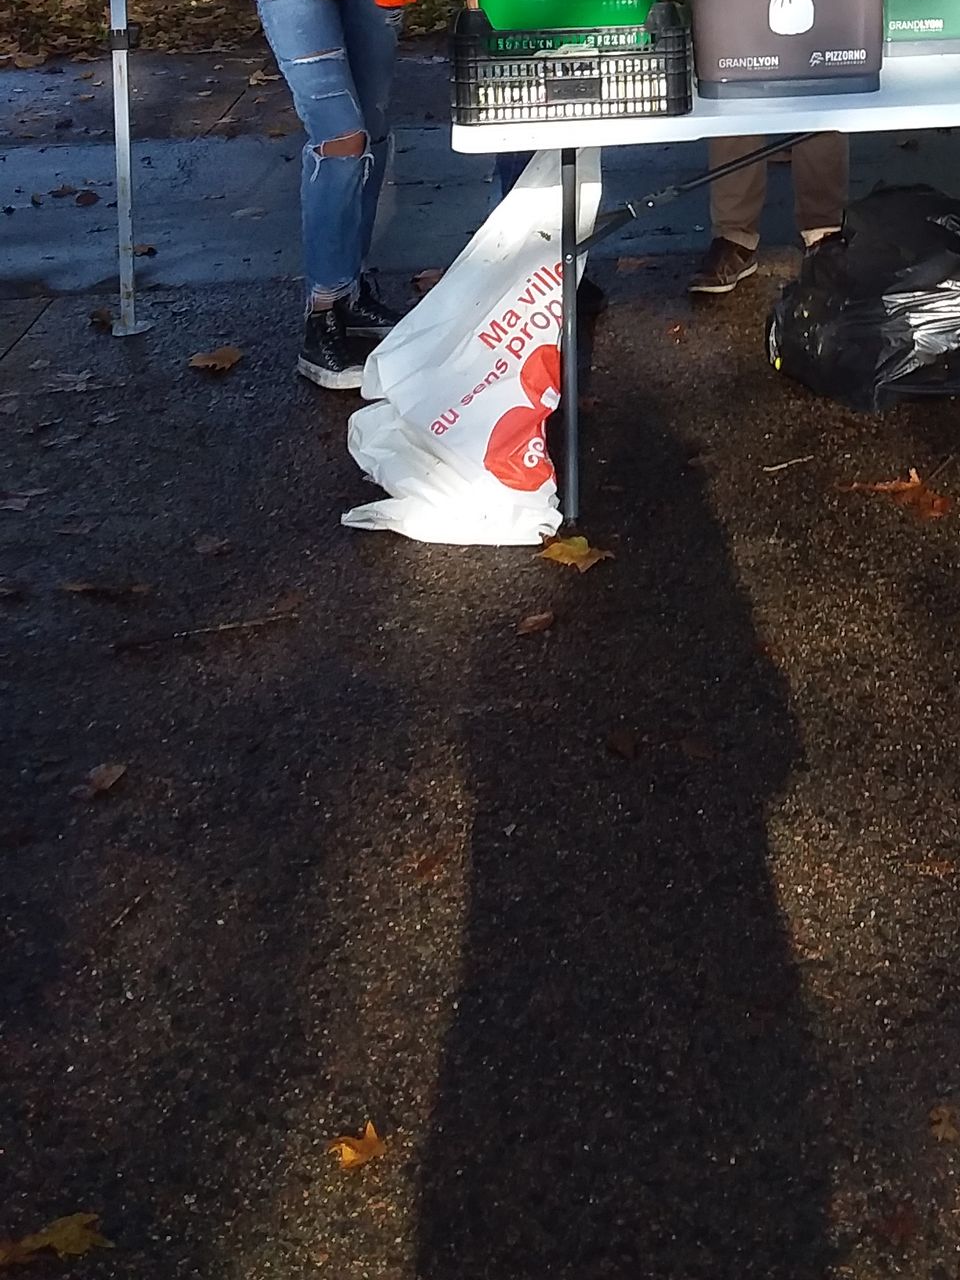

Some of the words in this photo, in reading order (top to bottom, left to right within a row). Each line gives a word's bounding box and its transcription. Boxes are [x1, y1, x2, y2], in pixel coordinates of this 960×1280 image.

[718, 56, 779, 68] GRANDLYON
[825, 49, 867, 61] PIZZORNO
[478, 309, 522, 350] Ma
[430, 409, 460, 436] au
[460, 358, 509, 407] sens
[505, 299, 563, 360] prop
